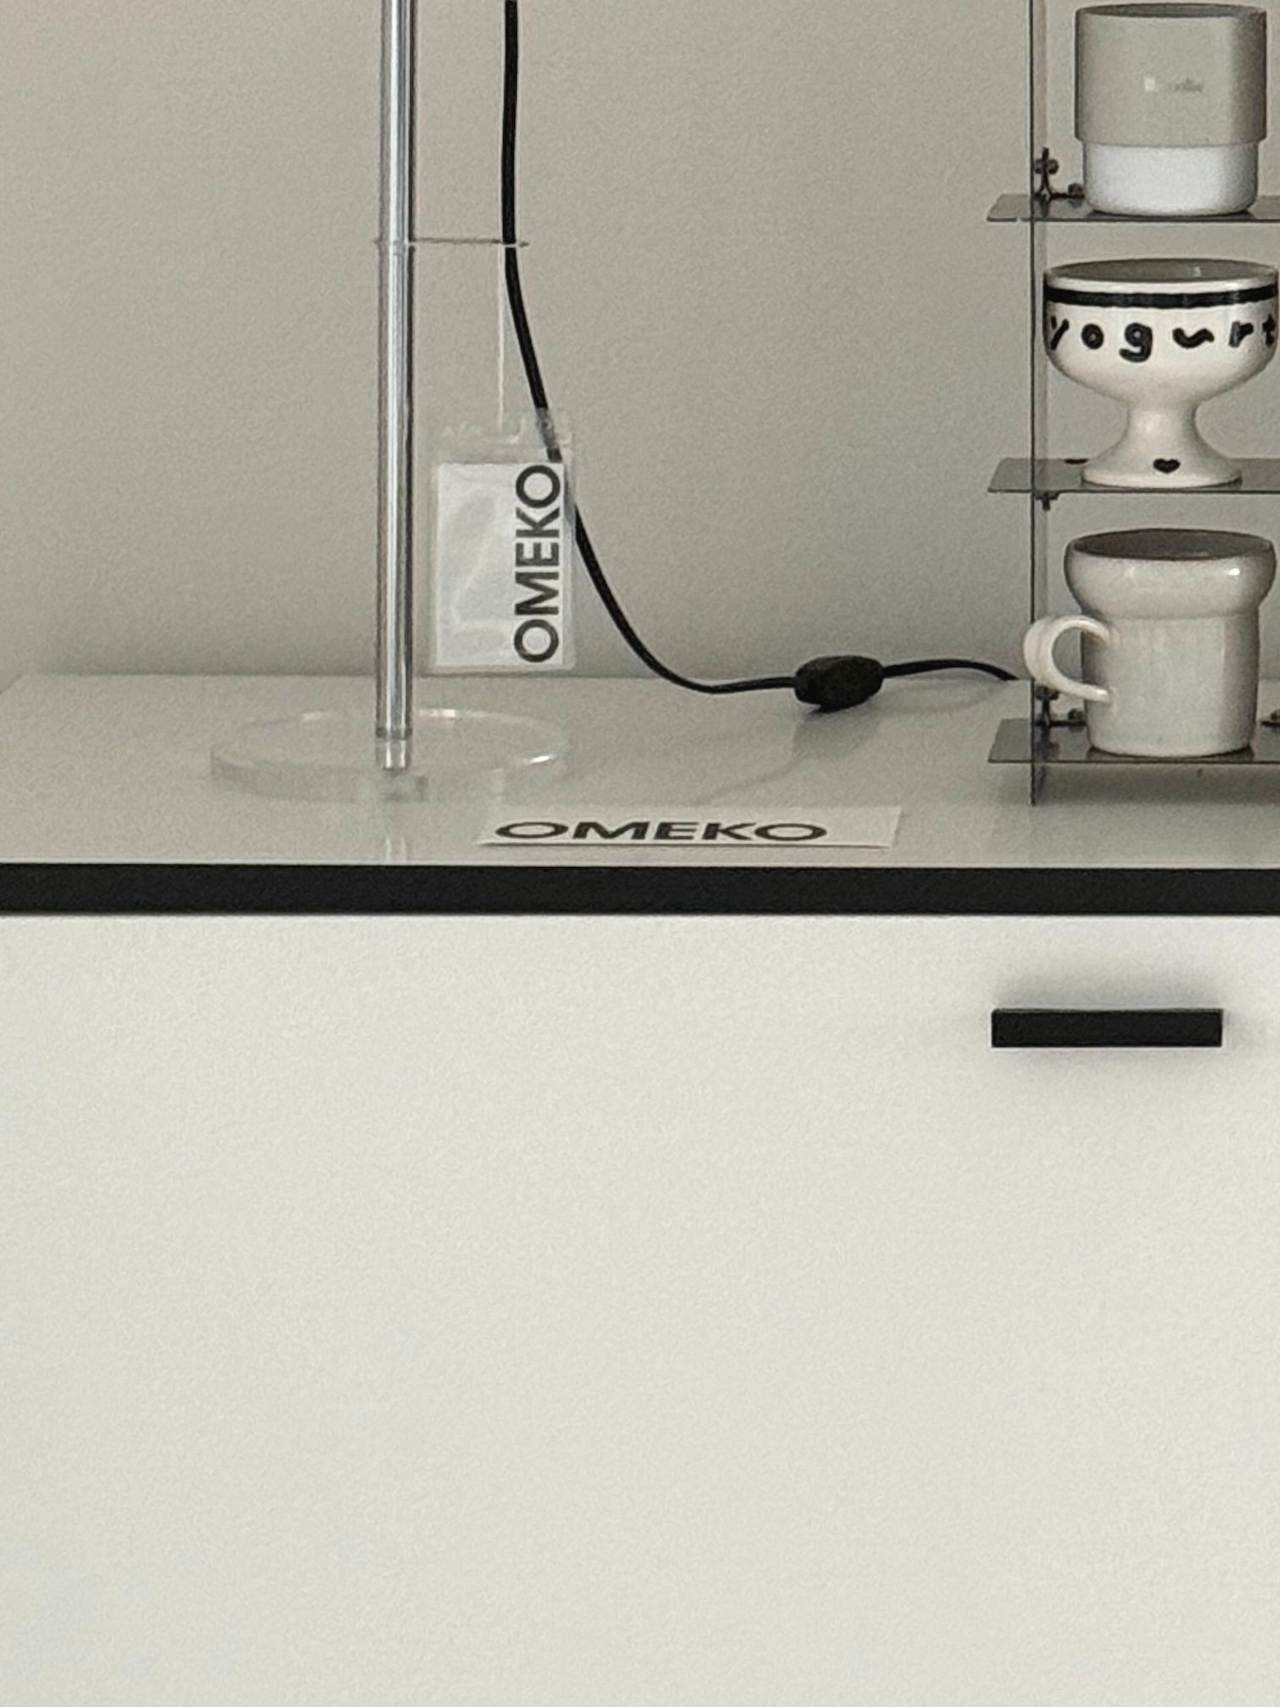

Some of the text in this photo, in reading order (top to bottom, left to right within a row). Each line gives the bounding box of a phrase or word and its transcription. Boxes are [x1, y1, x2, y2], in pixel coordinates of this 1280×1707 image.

[1049, 316, 1276, 362] yogurt
[513, 465, 560, 662] OMEKO
[496, 821, 827, 841] OMEKO
